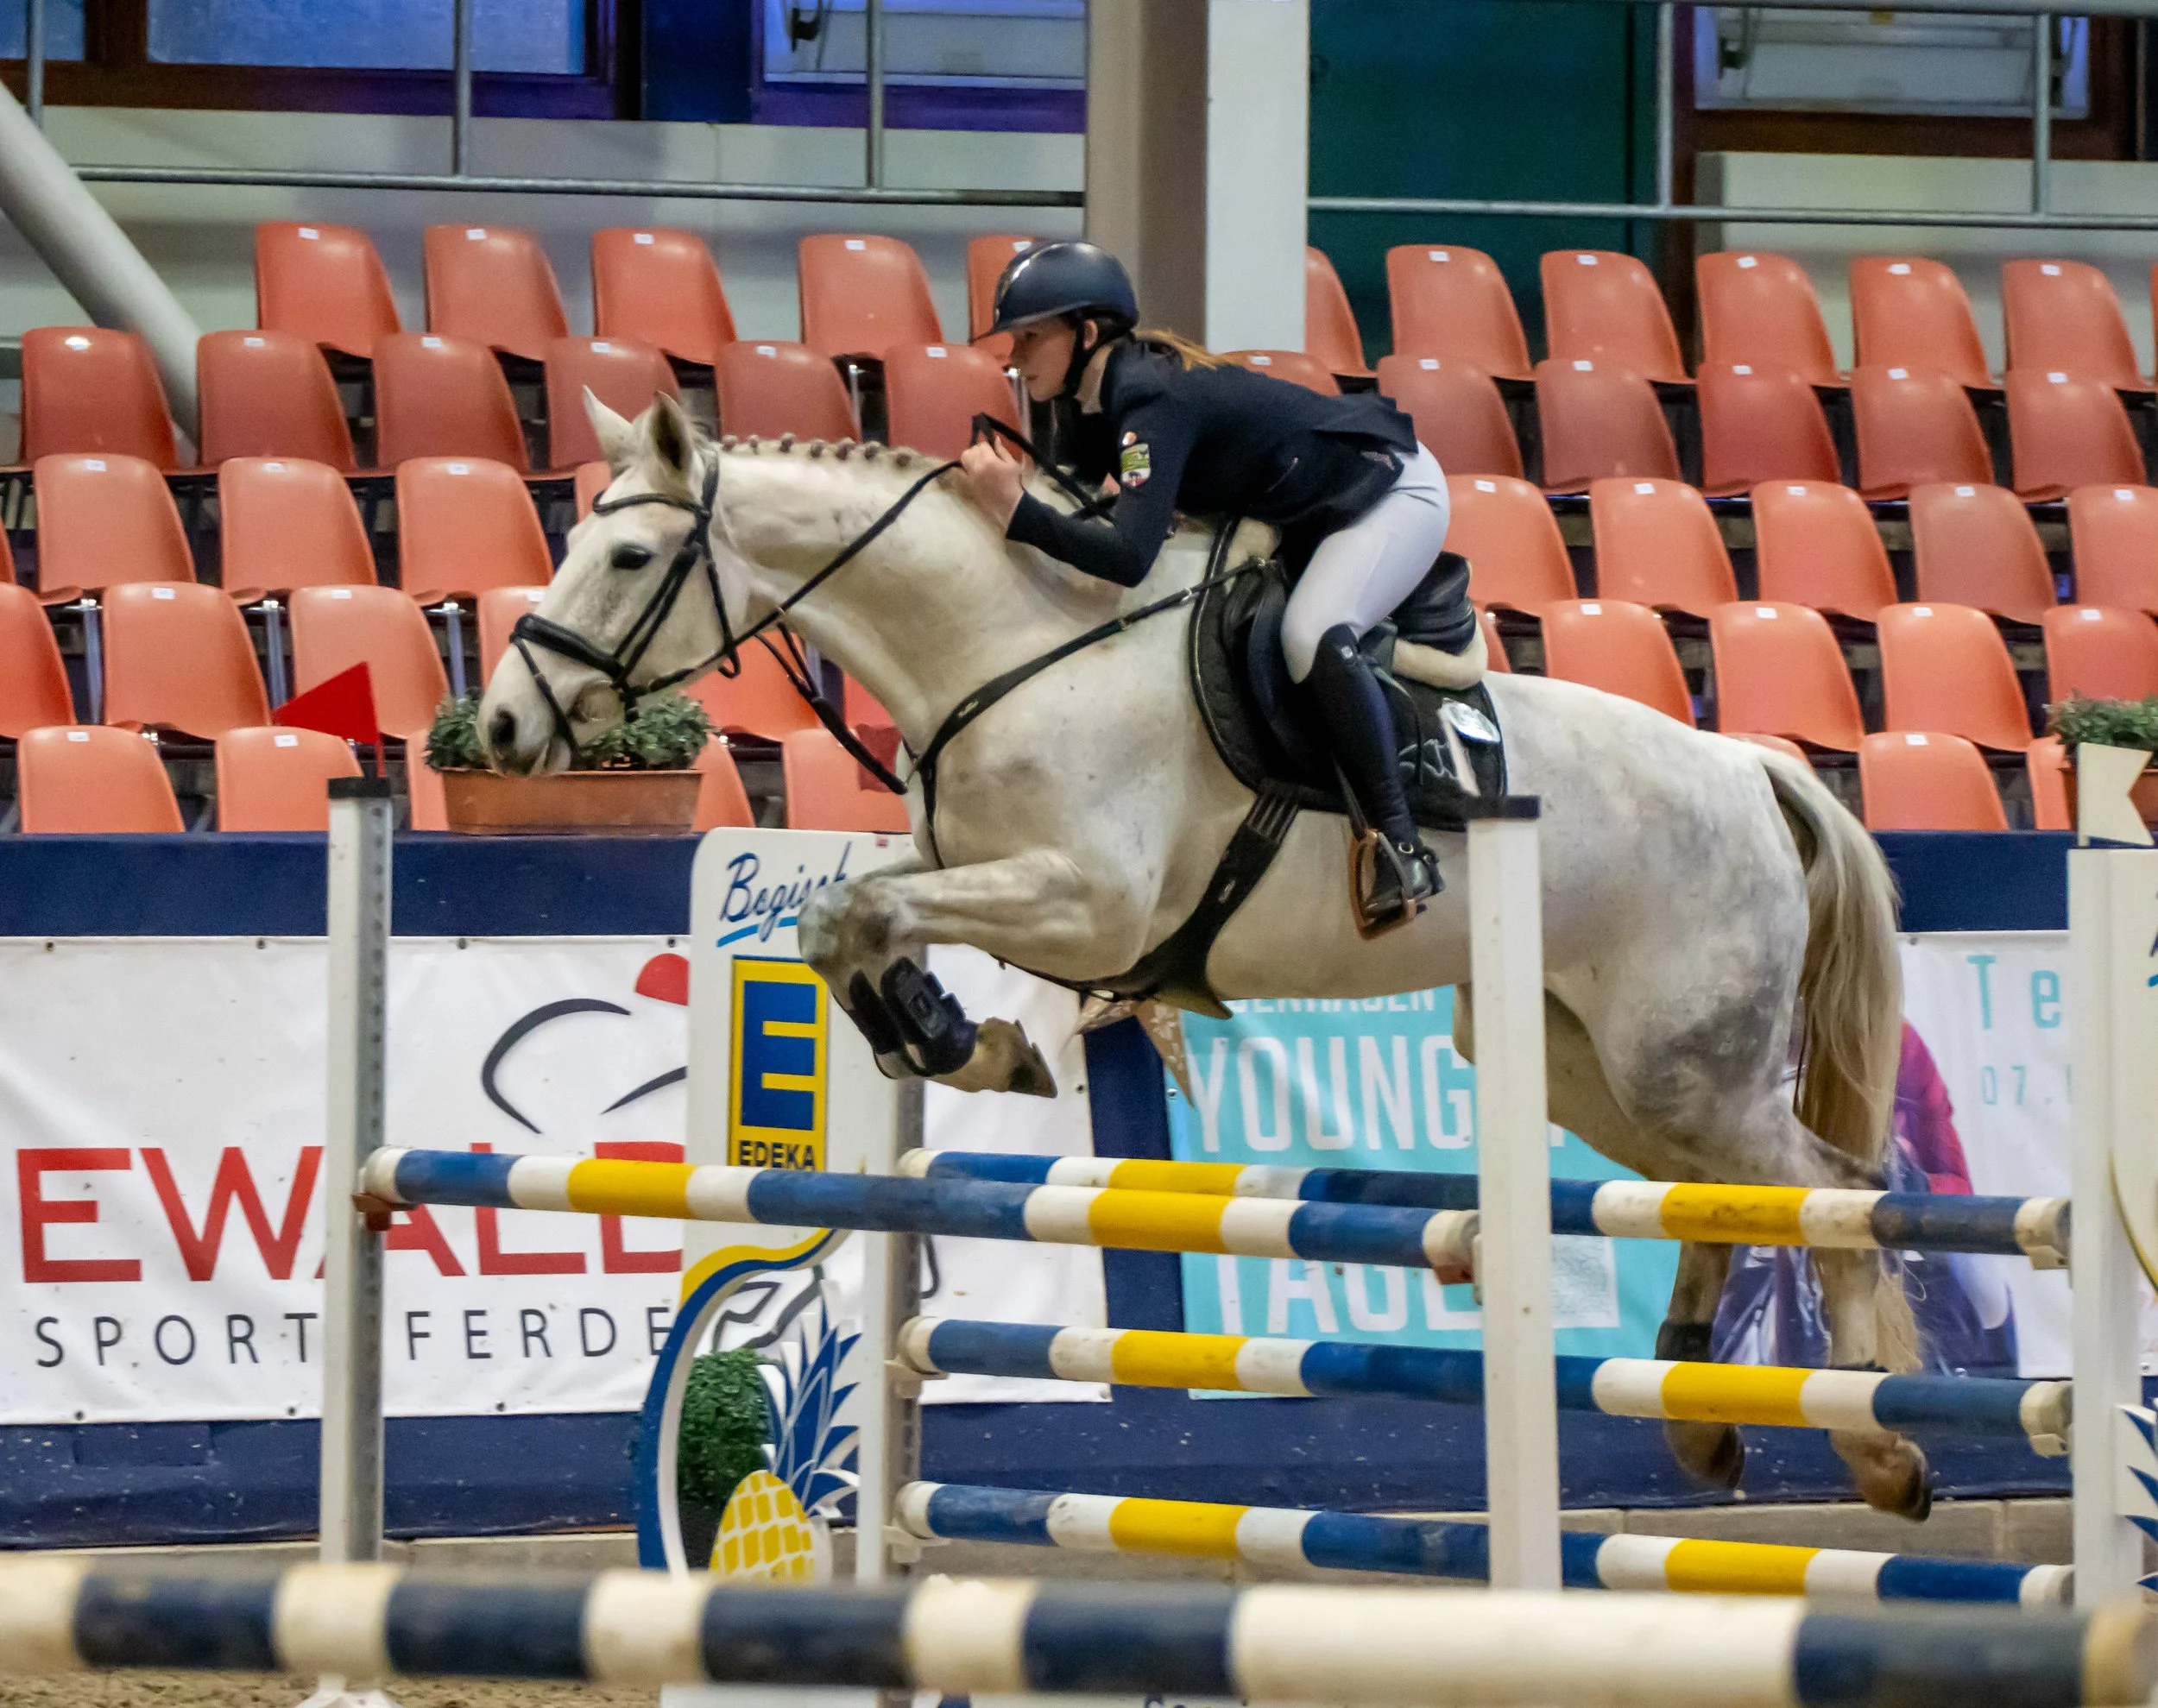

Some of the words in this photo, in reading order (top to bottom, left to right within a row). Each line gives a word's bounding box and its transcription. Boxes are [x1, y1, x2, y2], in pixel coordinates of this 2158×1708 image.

[1184, 1035, 1564, 1153] YOUNG
[739, 1139, 816, 1171] EDEKA
[35, 1308, 672, 1368] SPORTFERDE
